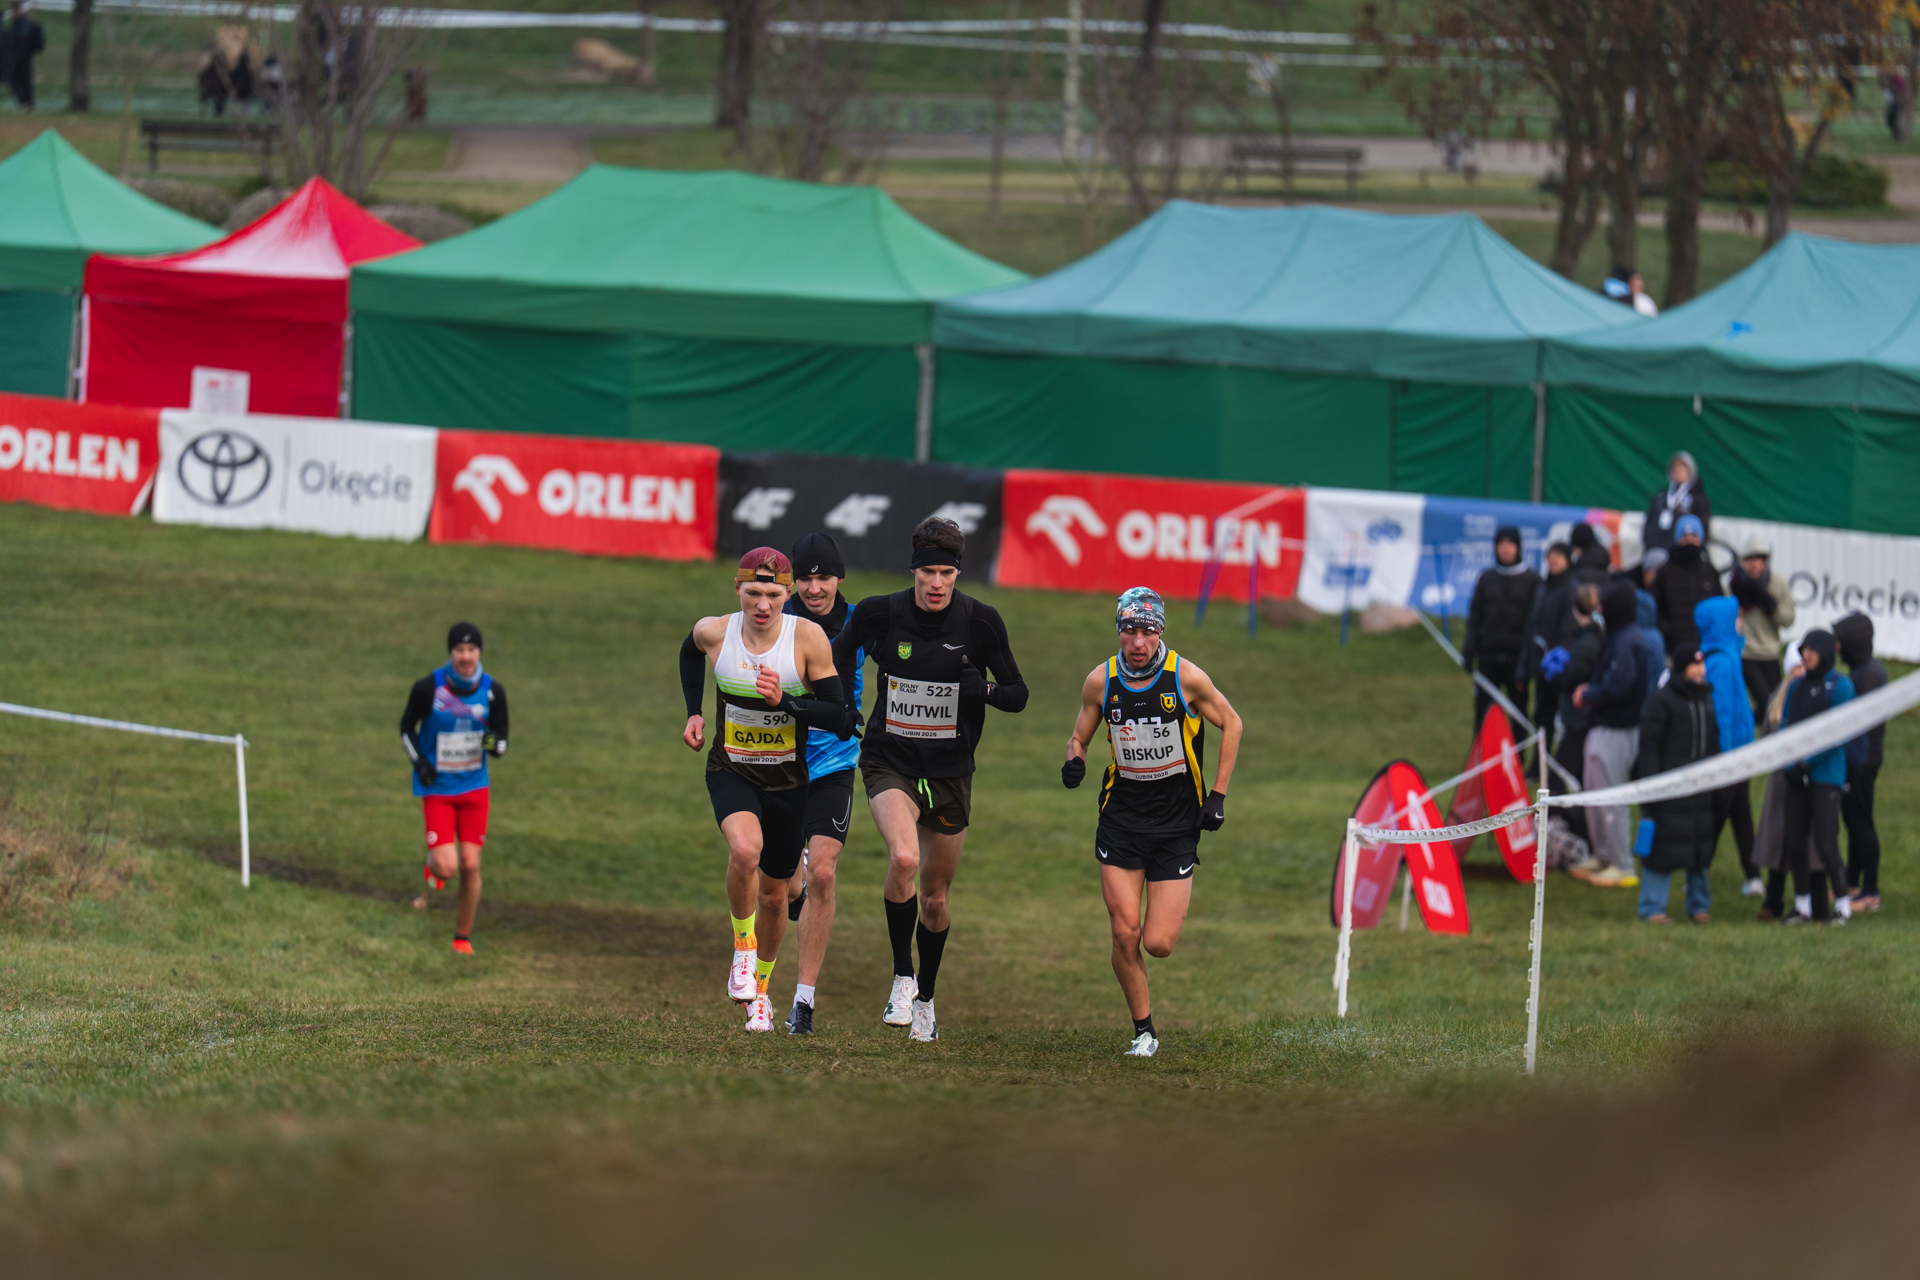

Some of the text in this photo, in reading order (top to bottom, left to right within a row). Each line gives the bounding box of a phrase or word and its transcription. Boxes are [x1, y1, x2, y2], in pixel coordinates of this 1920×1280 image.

[0, 425, 139, 483] ORLEN
[538, 468, 695, 524] ORLEN
[732, 487, 795, 530] 4F
[825, 493, 891, 536] 4F
[1116, 509, 1281, 568] ORLEN
[899, 682, 919, 690] DOLNY
[926, 685, 953, 697] 522
[891, 700, 953, 719] MUTWIL
[763, 713, 790, 726] 590
[734, 730, 786, 745] GAJDA
[902, 729, 921, 737] LUBIN
[1153, 726, 1170, 739] 56
[1122, 745, 1174, 761] BISKUP
